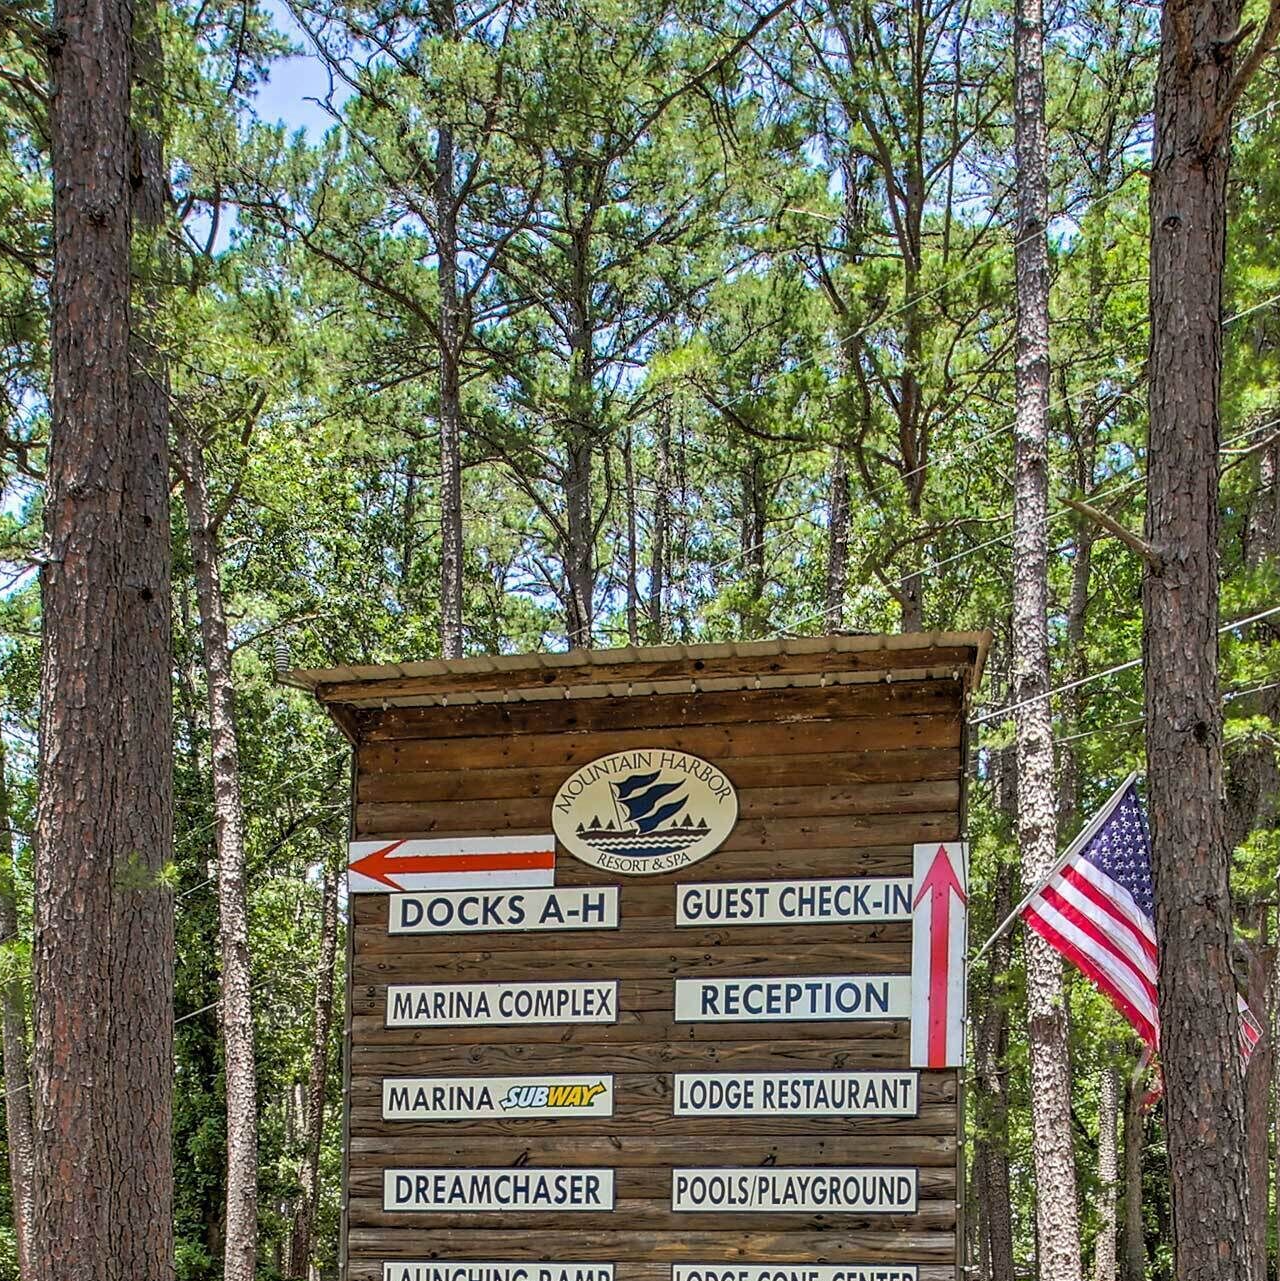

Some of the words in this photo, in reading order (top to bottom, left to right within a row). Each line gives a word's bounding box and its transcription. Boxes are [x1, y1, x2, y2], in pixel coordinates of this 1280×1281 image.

[555, 752, 651, 814] MOUNTAIN
[660, 752, 732, 804] HARBOR
[597, 853, 647, 872] RESORT
[652, 859, 664, 870] &
[667, 852, 691, 868] SPA
[400, 895, 525, 927] DOCKS
[539, 893, 605, 924] A-H
[683, 887, 769, 920] GUEST
[779, 884, 912, 917] CHECK-IN
[393, 991, 491, 1019] MARINA
[499, 988, 612, 1017] COMPLEX
[701, 982, 889, 1015] RECEPTION
[388, 1086, 494, 1111] MARINA
[499, 1081, 606, 1111] SUBWAY
[679, 1079, 754, 1109] LODGE
[763, 1079, 911, 1109] RESTAURANT
[395, 1175, 600, 1205] DREAMCHASER
[677, 1176, 912, 1206] POOLS/PLAYGROUND
